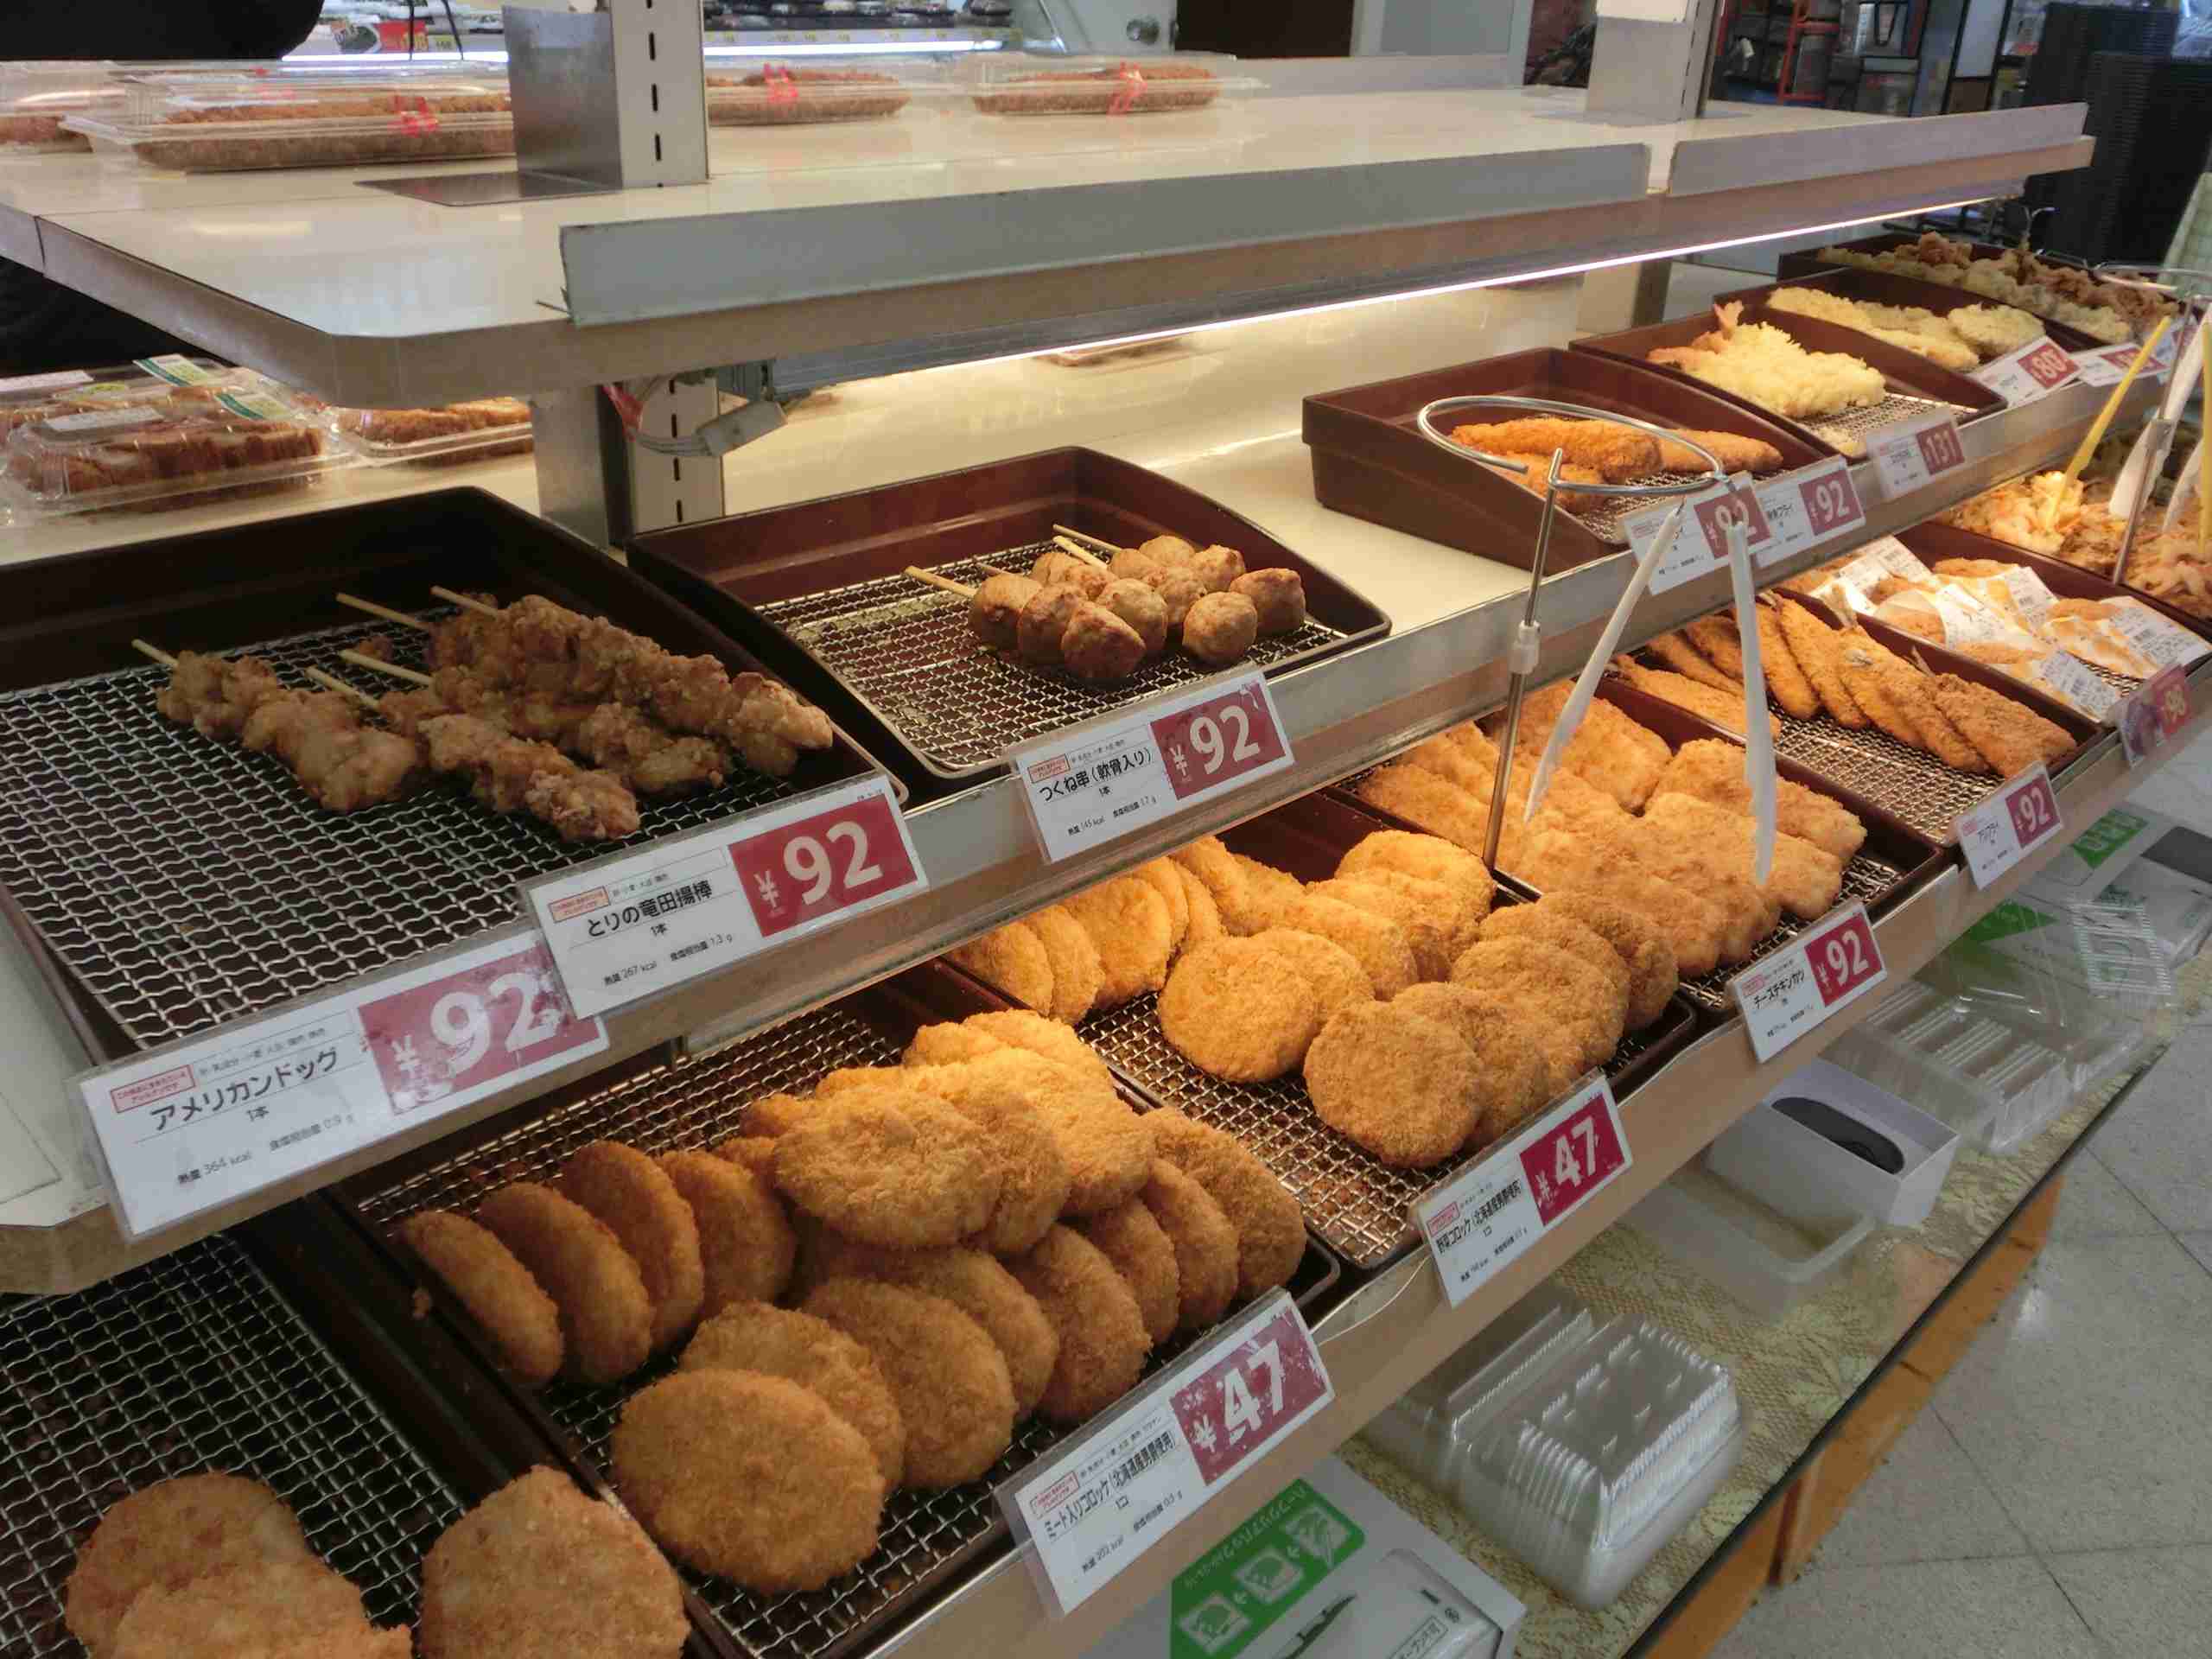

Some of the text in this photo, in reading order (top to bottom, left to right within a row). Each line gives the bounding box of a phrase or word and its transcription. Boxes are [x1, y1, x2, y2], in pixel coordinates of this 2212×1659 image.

[588, 878, 713, 938] とりの竜田揚棒
[150, 1046, 338, 1132] アメリカンドッグ
